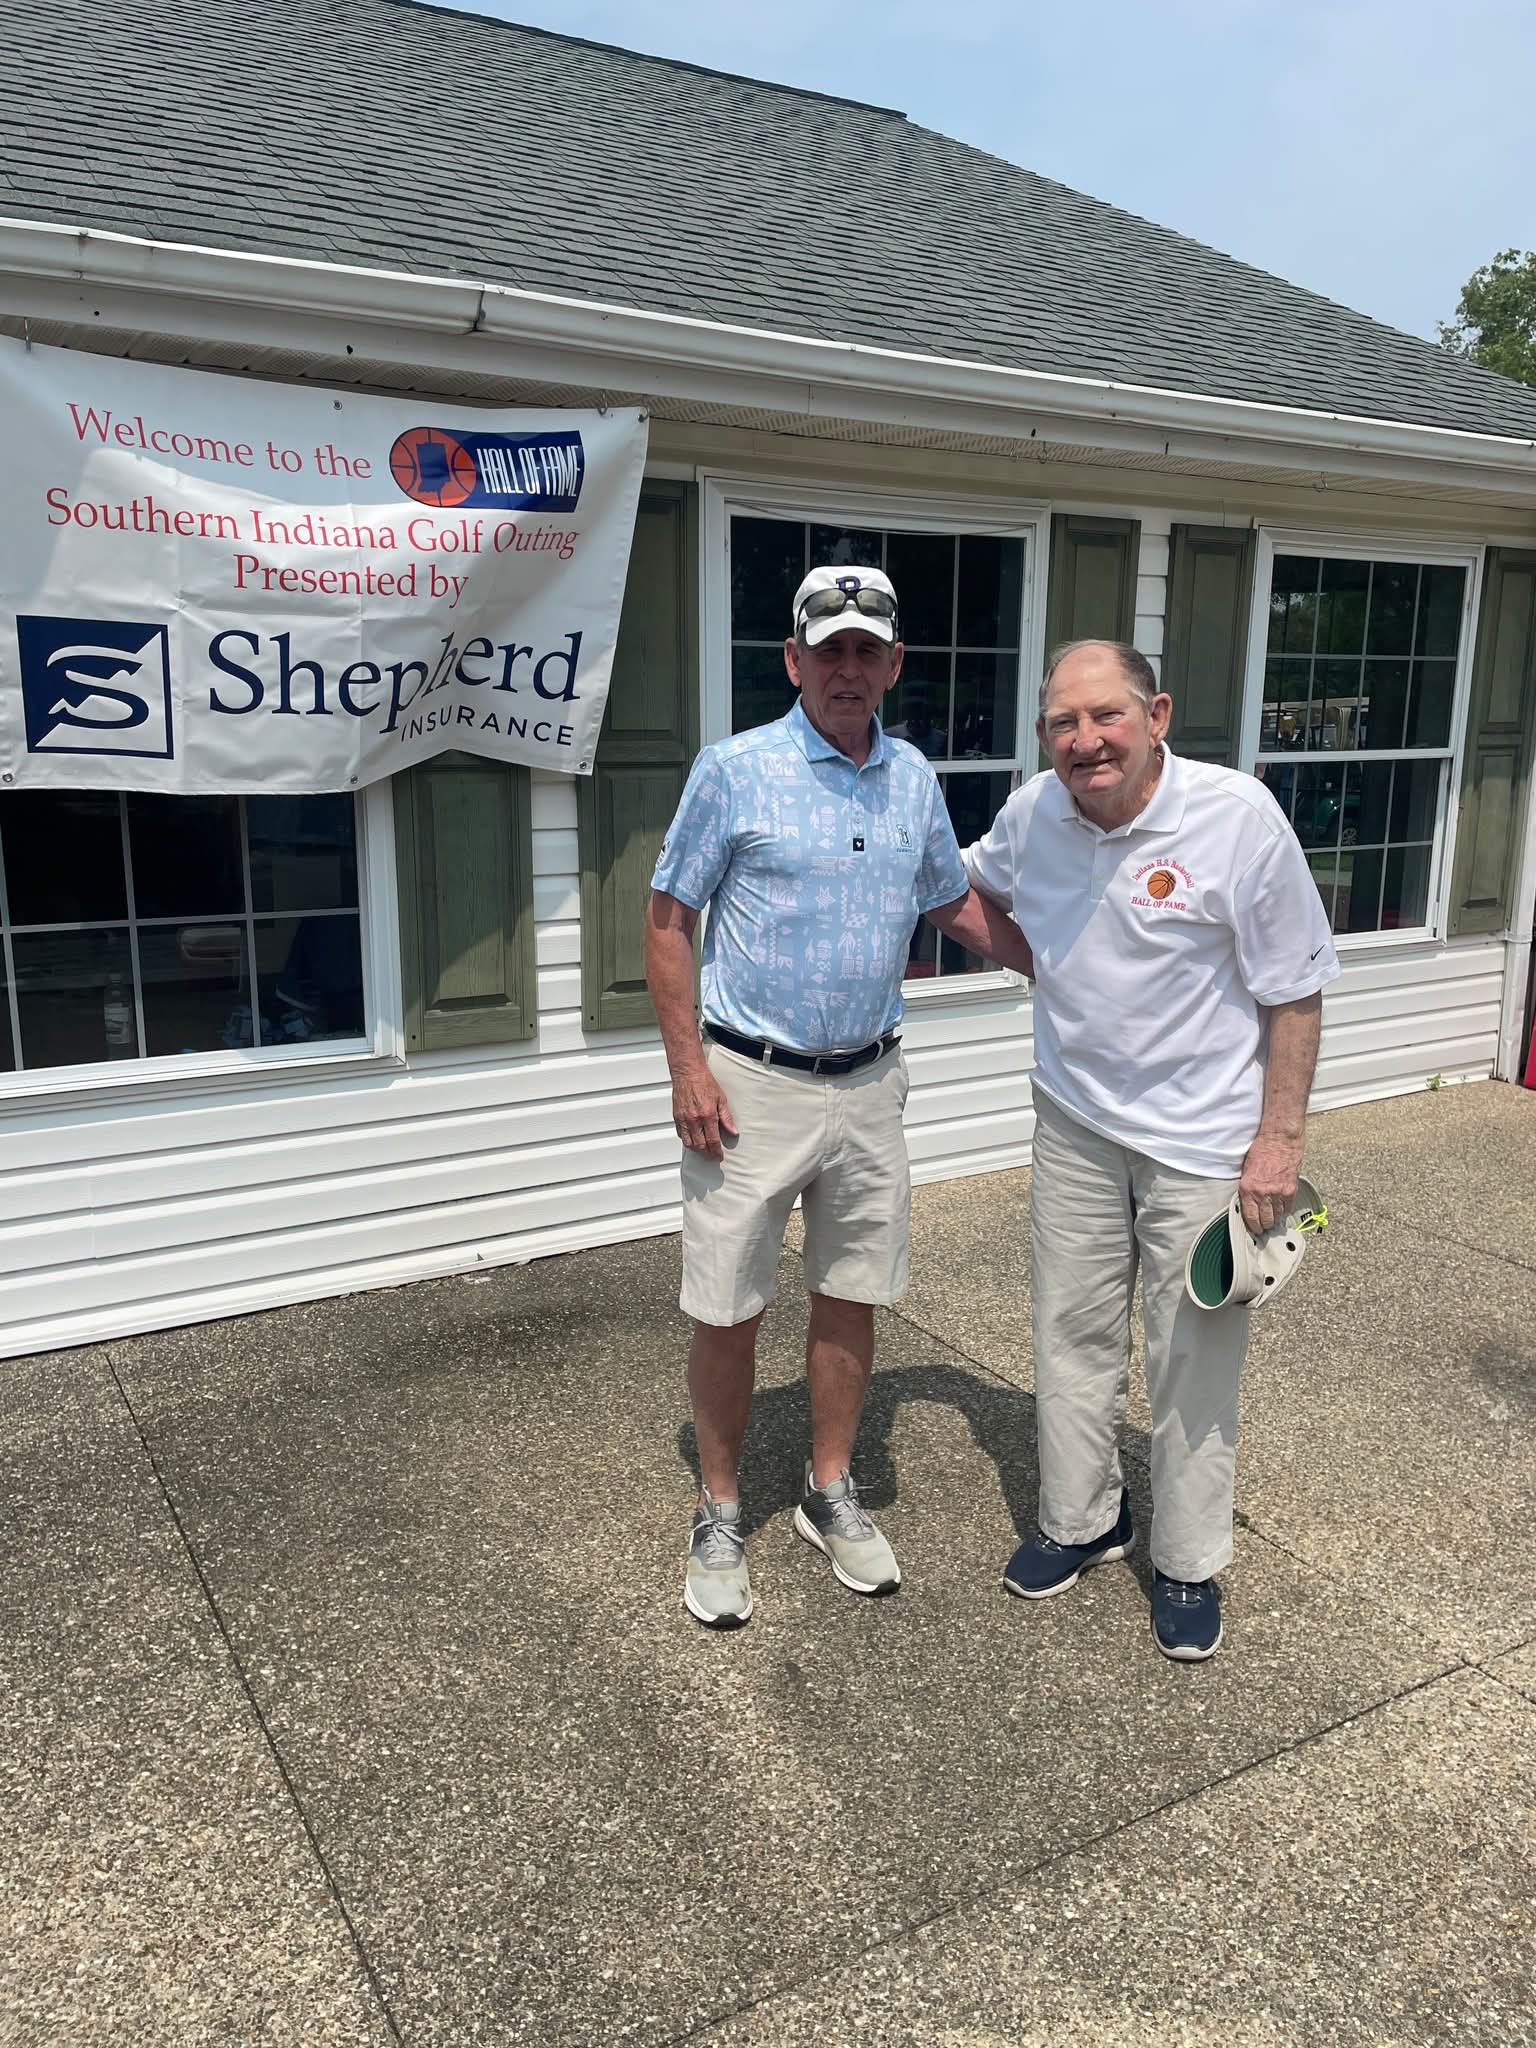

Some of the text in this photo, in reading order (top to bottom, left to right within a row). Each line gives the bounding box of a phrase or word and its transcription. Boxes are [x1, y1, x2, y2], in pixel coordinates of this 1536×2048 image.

[66, 402, 372, 479] Welcome to the
[476, 444, 581, 497] HALL OF FAME
[46, 487, 580, 560] Southern Indiana Golf Outing
[233, 554, 469, 609] Presented by
[208, 629, 583, 735] Shepherd
[400, 704, 575, 747] INSURANCE
[1131, 896, 1187, 912] HALL OF FAME
